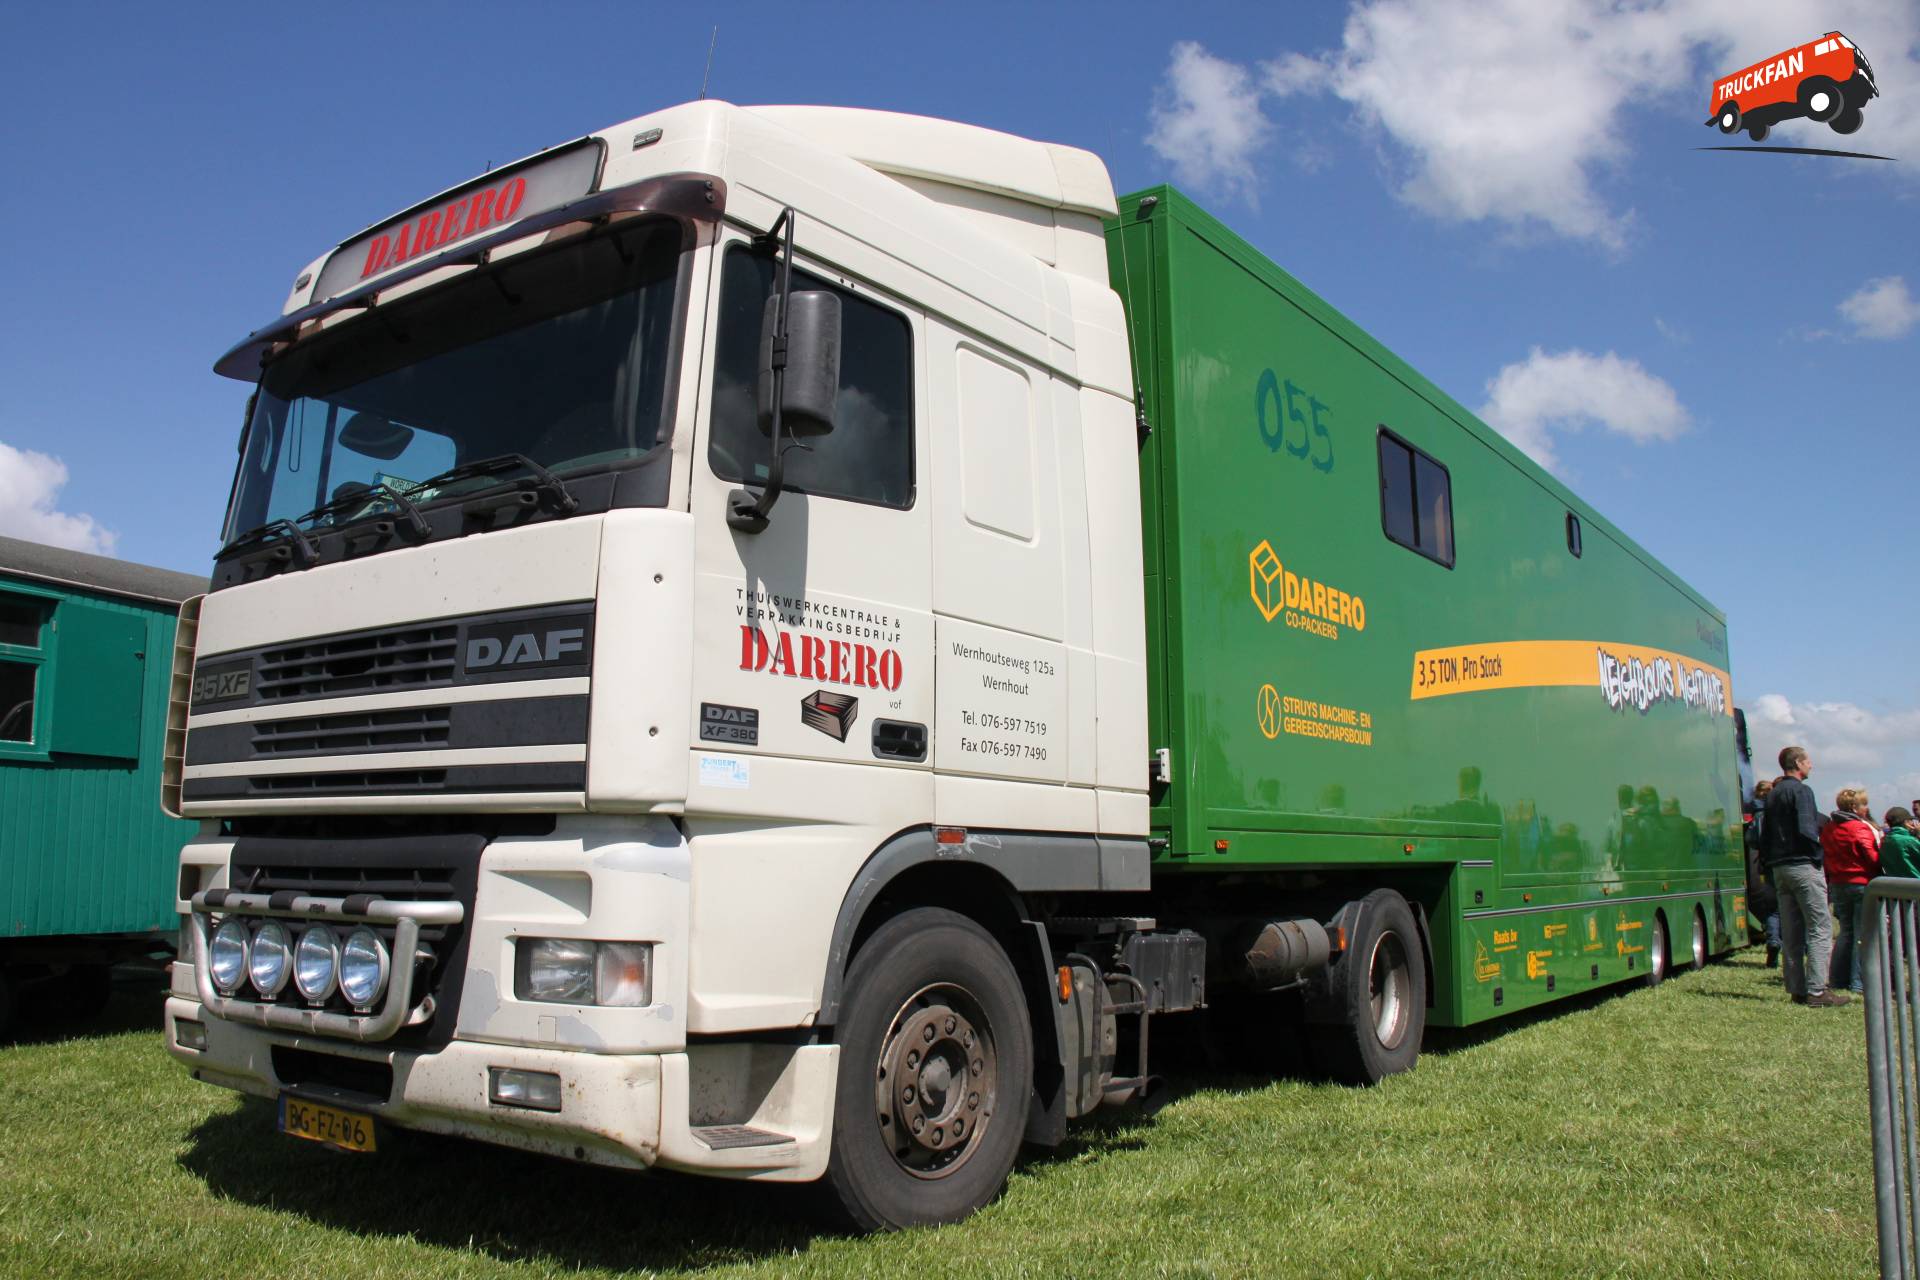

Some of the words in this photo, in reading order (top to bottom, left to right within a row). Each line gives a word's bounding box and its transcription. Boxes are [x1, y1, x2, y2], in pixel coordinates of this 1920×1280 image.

[360, 176, 526, 279] DARERO
[1256, 367, 1335, 474] 055
[736, 588, 888, 627] THUISWERKCENTRALE
[894, 618, 901, 629] &
[1284, 570, 1366, 631] DARERO
[736, 605, 901, 643] VERPAKKINGSBEDRIJF
[1285, 610, 1338, 640] CO-PACKERS
[466, 628, 583, 668] DAF
[739, 624, 903, 692] DARERO
[952, 641, 1030, 675] Wernhoutseweg
[1033, 660, 1055, 676] 125a
[982, 674, 1029, 696] Wernhout
[1418, 660, 1437, 688] 3,5
[1438, 657, 1460, 684] TON,
[1462, 656, 1478, 680] Pro
[1479, 653, 1502, 679] Stock
[1597, 646, 1675, 715] NEIGHBOURS
[1676, 658, 1726, 718] NIGHTMARE
[706, 706, 756, 723] DAF
[889, 699, 902, 710] vof
[1283, 696, 1318, 719] STRUYS
[1319, 704, 1359, 725] MACHINE-
[1360, 712, 1371, 728] EN
[703, 725, 727, 737] XF
[730, 727, 757, 740] 380
[961, 710, 978, 726] Tel.
[980, 713, 1022, 732] 076-597
[1024, 720, 1047, 736] 7519
[1283, 716, 1372, 746] GEREEDSCHAPSBOUW
[960, 737, 978, 753] Fax
[980, 740, 1022, 758] 076-597
[1024, 746, 1047, 761] 7490
[289, 1104, 366, 1145] BG-FZ-06
